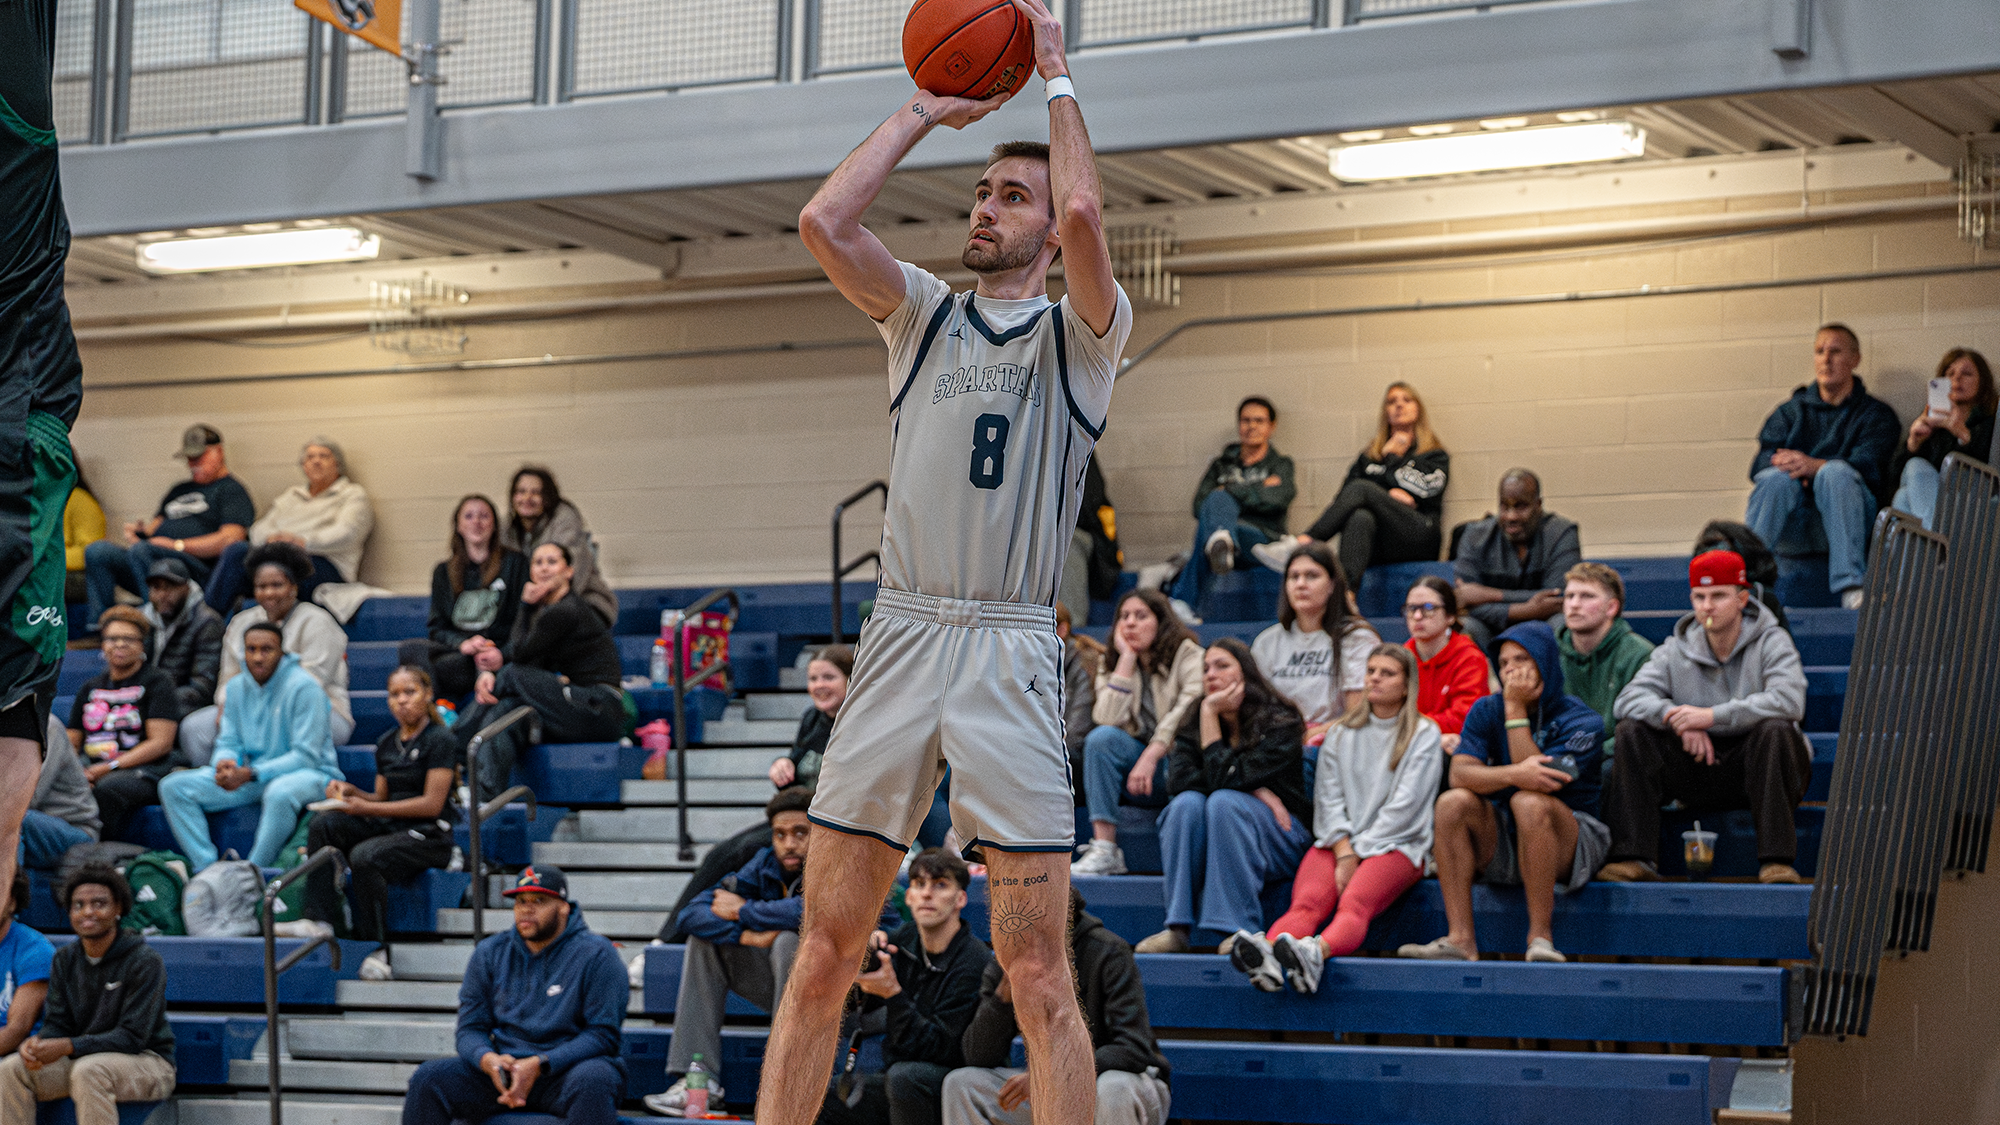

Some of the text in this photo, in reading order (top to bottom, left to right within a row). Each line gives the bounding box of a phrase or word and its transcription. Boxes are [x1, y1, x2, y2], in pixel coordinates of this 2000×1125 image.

[932, 362, 1041, 407] SPARTAS
[969, 413, 1010, 490] 8
[1286, 649, 1332, 666] MBU
[1002, 876, 1019, 886] the
[1023, 872, 1049, 887] good
